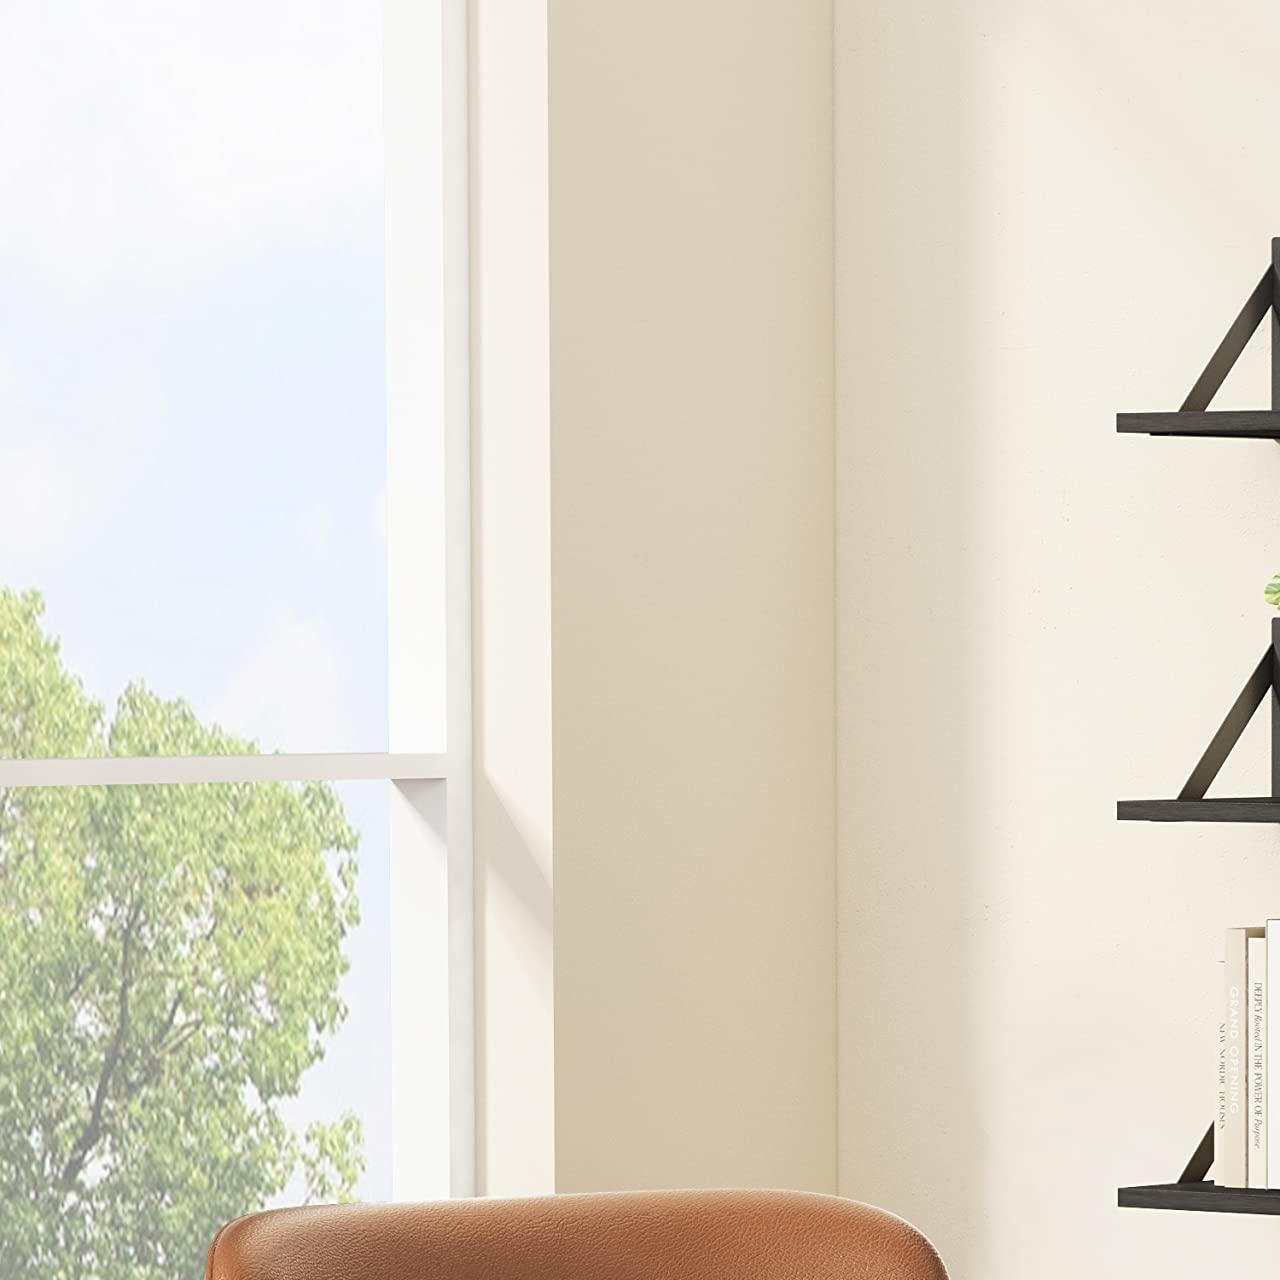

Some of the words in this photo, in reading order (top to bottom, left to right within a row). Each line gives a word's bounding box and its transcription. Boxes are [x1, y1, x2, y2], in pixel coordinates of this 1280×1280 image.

[1230, 986, 1240, 1039] GRAND
[1254, 1055, 1263, 1071] THE
[1230, 1046, 1240, 1114] OPENING
[1254, 1073, 1263, 1103] POWER
[1254, 1106, 1263, 1118] OF
